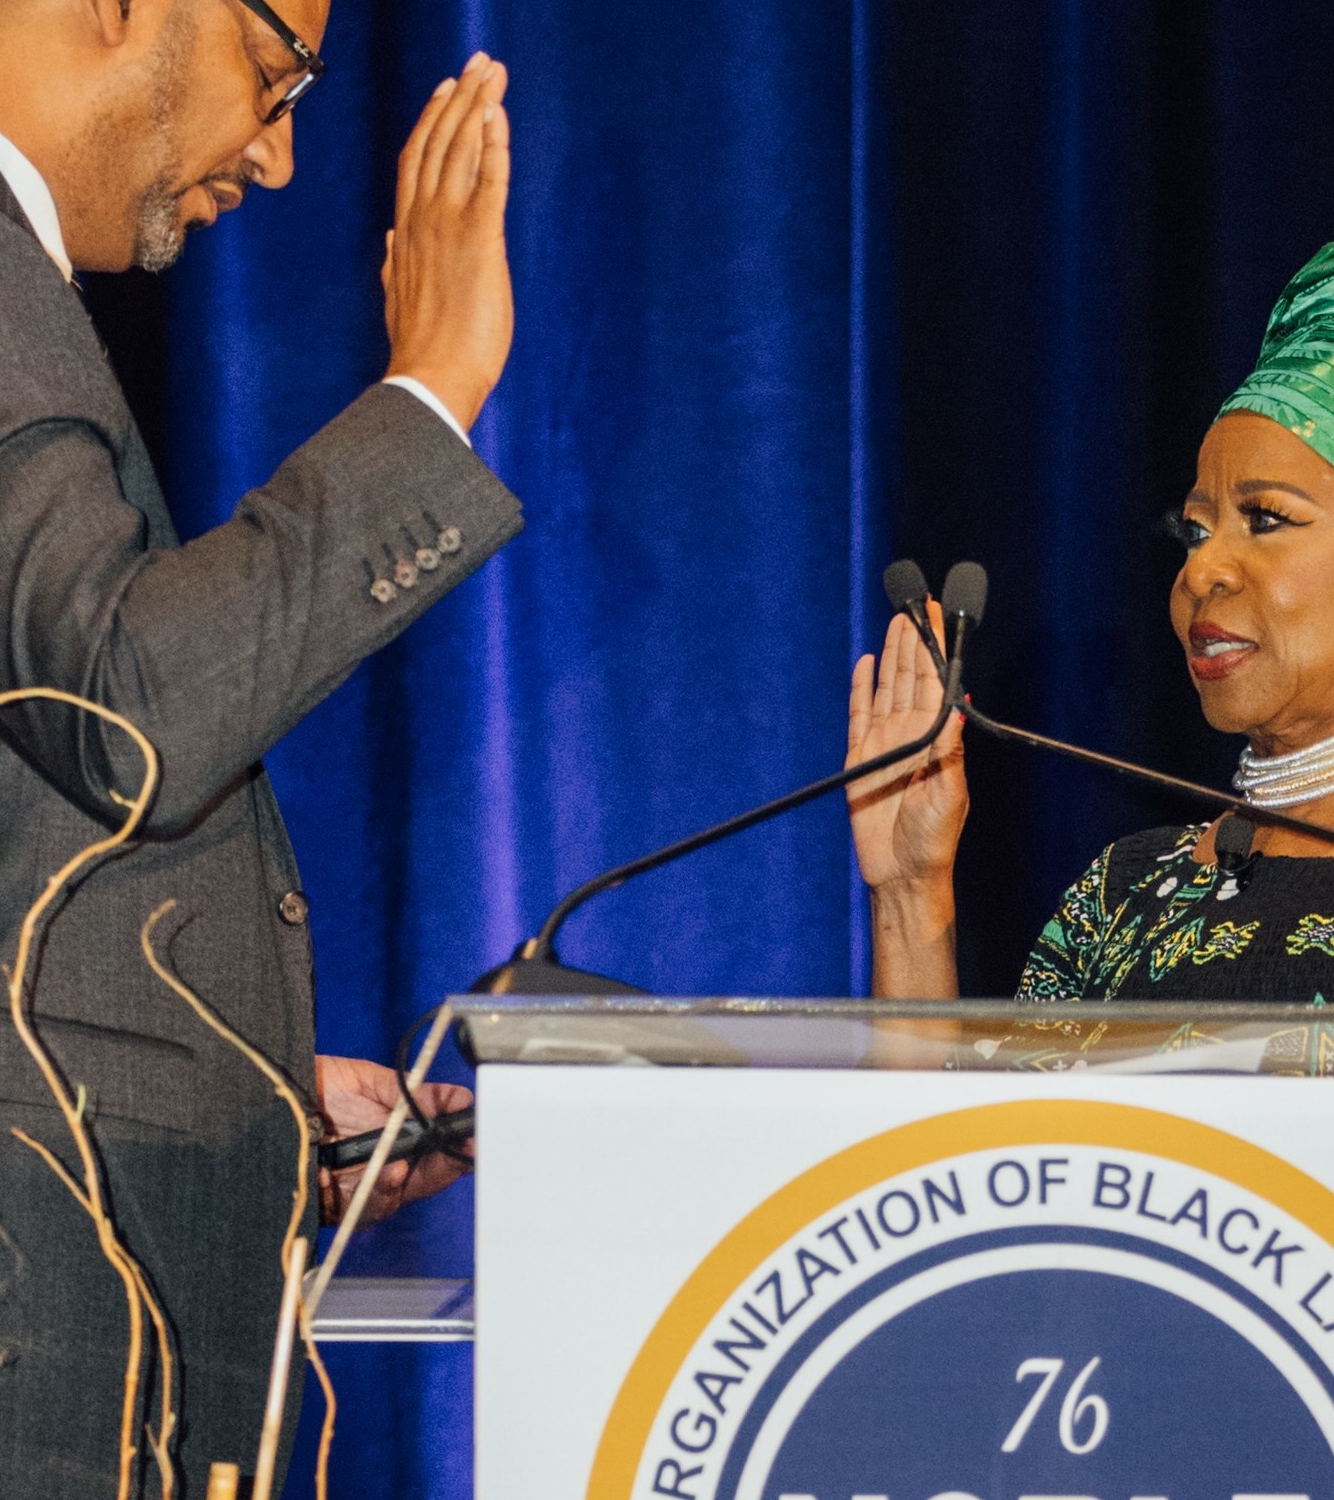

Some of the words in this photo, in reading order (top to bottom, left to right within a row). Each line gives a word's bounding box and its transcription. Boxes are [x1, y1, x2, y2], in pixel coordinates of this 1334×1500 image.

[987, 1157, 1070, 1208] OF
[1092, 1161, 1304, 1287] BLACK
[1000, 1355, 1111, 1456] 76
